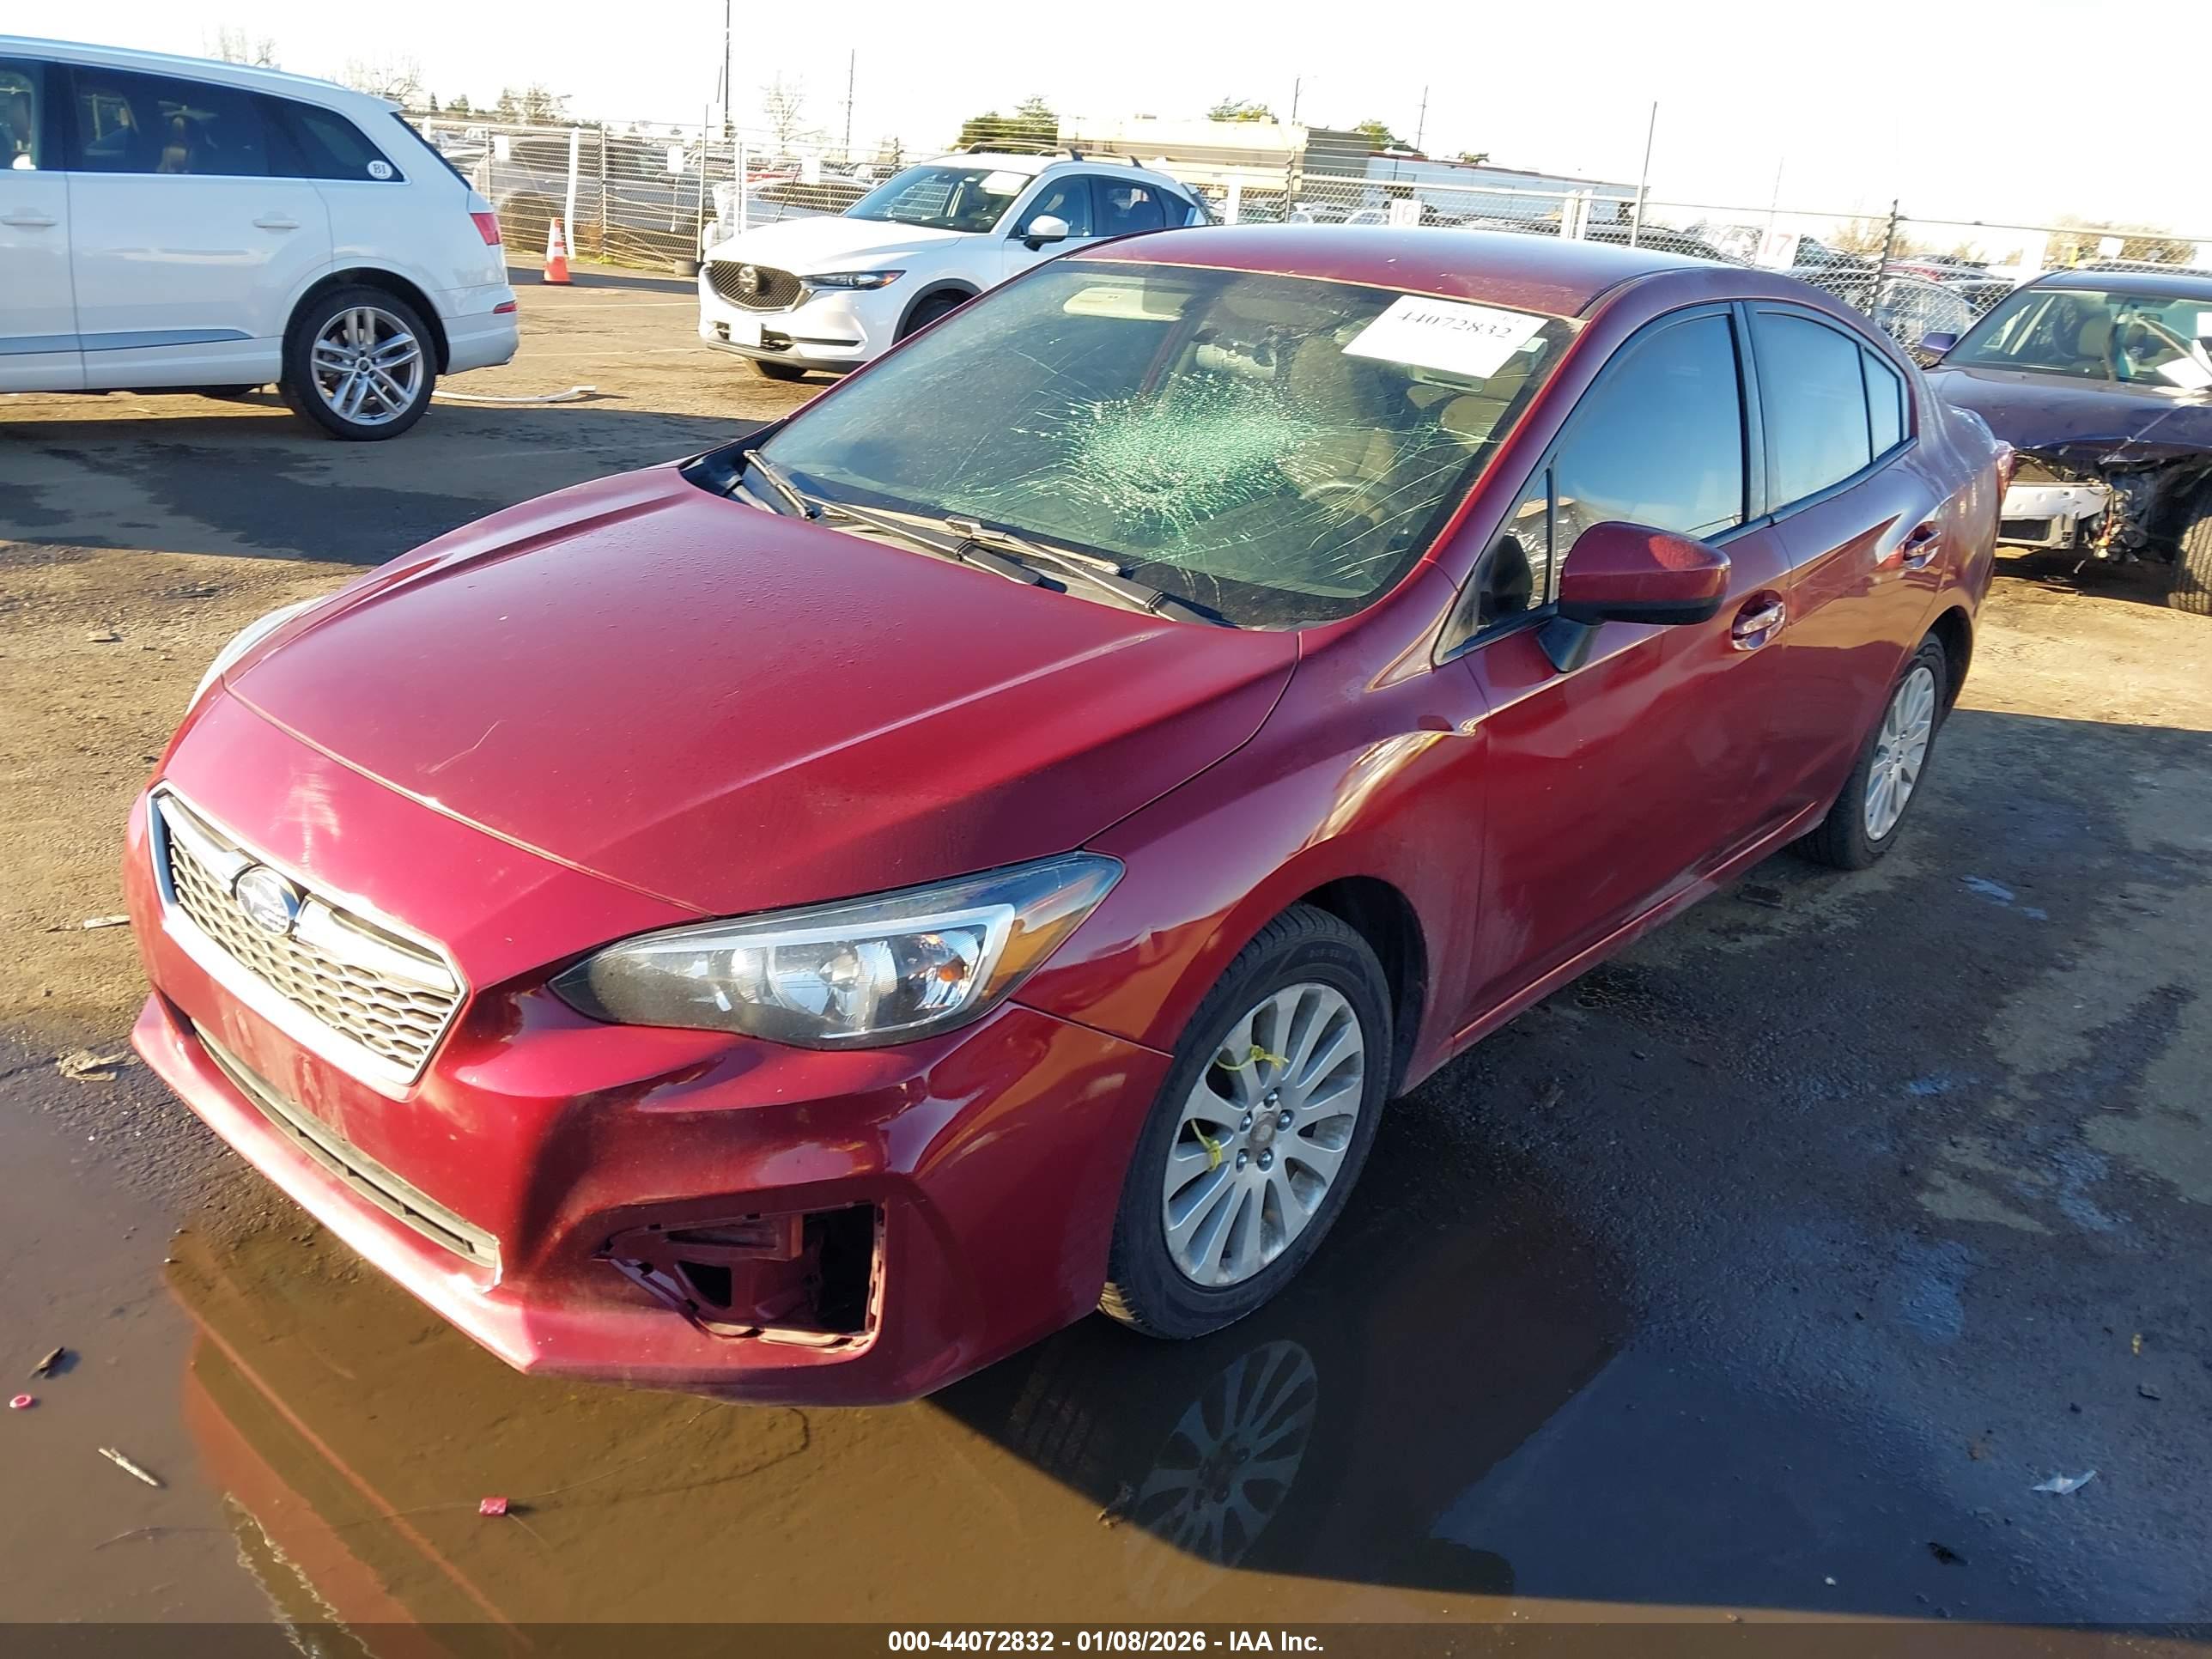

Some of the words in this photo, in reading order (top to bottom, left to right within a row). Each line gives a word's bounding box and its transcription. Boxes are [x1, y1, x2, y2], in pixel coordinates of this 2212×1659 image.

[1394, 202, 1415, 225] 16
[1763, 233, 1794, 257] 17
[1396, 310, 1512, 338] 44072832
